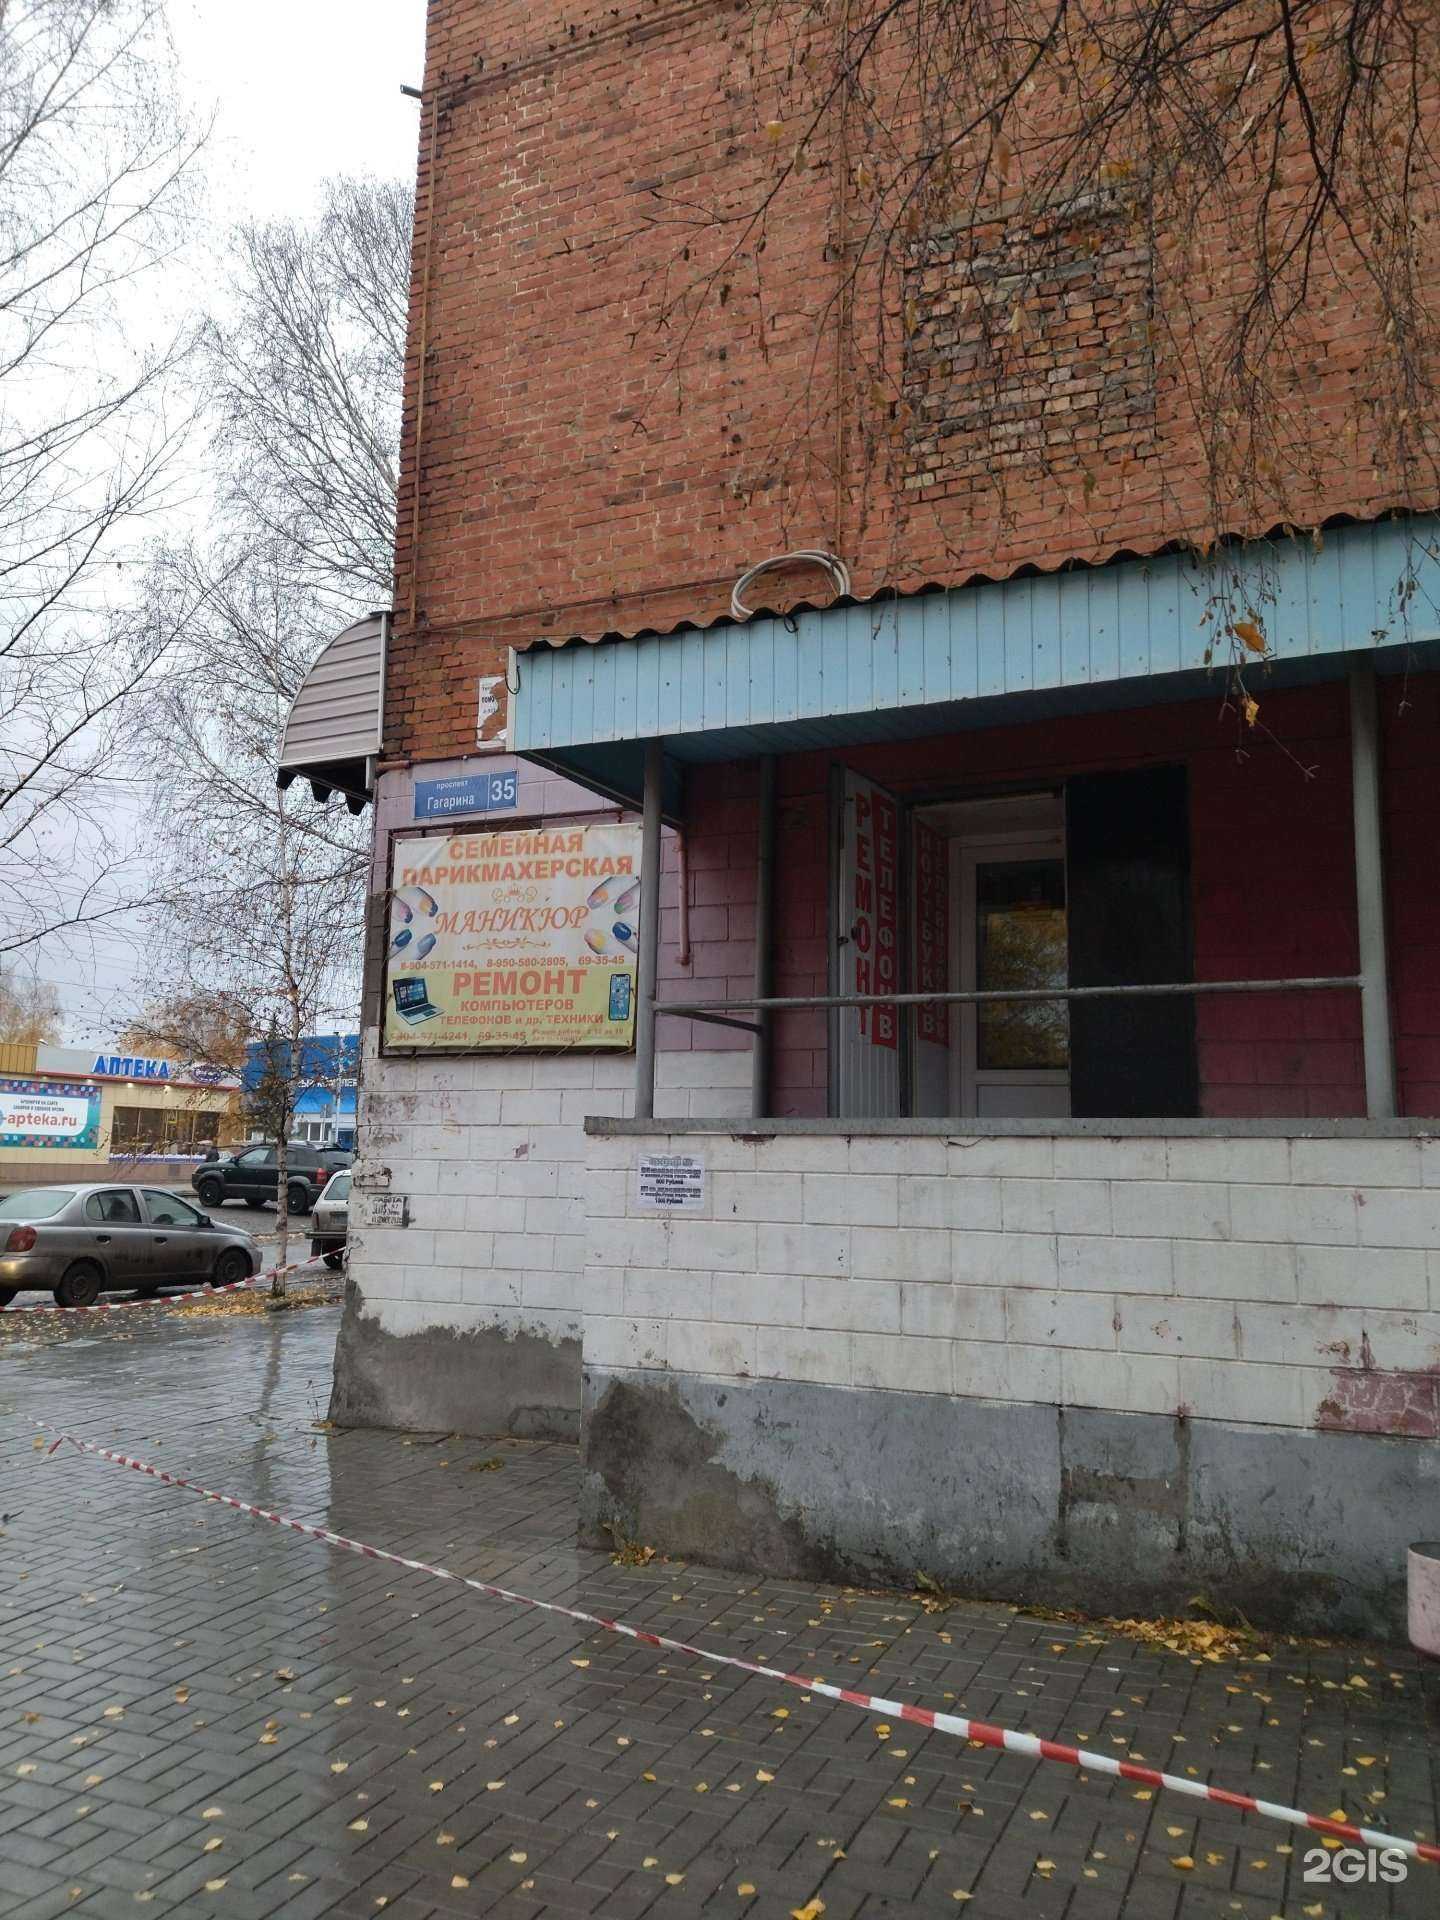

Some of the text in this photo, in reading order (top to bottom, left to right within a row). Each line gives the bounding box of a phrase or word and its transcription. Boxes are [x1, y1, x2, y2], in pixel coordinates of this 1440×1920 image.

[436, 780, 468, 791] проспект
[491, 778, 515, 801] 35
[427, 795, 475, 810] Гагарина
[449, 833, 583, 860] СЕМЕЙНАЯ
[402, 856, 633, 886] ПАРИКМАХЕРСКАЯ
[434, 906, 590, 934] МАНИКЮР
[452, 969, 588, 996] РЕМОНТ
[460, 999, 573, 1012] КОМПЬЮТЕРОВ
[440, 1014, 512, 1025] ТЕЛЕФОНОВ
[515, 1016, 522, 1024] и
[547, 1013, 604, 1025] ТЕХНИКИ
[93, 1055, 168, 1079] АПТЕКА
